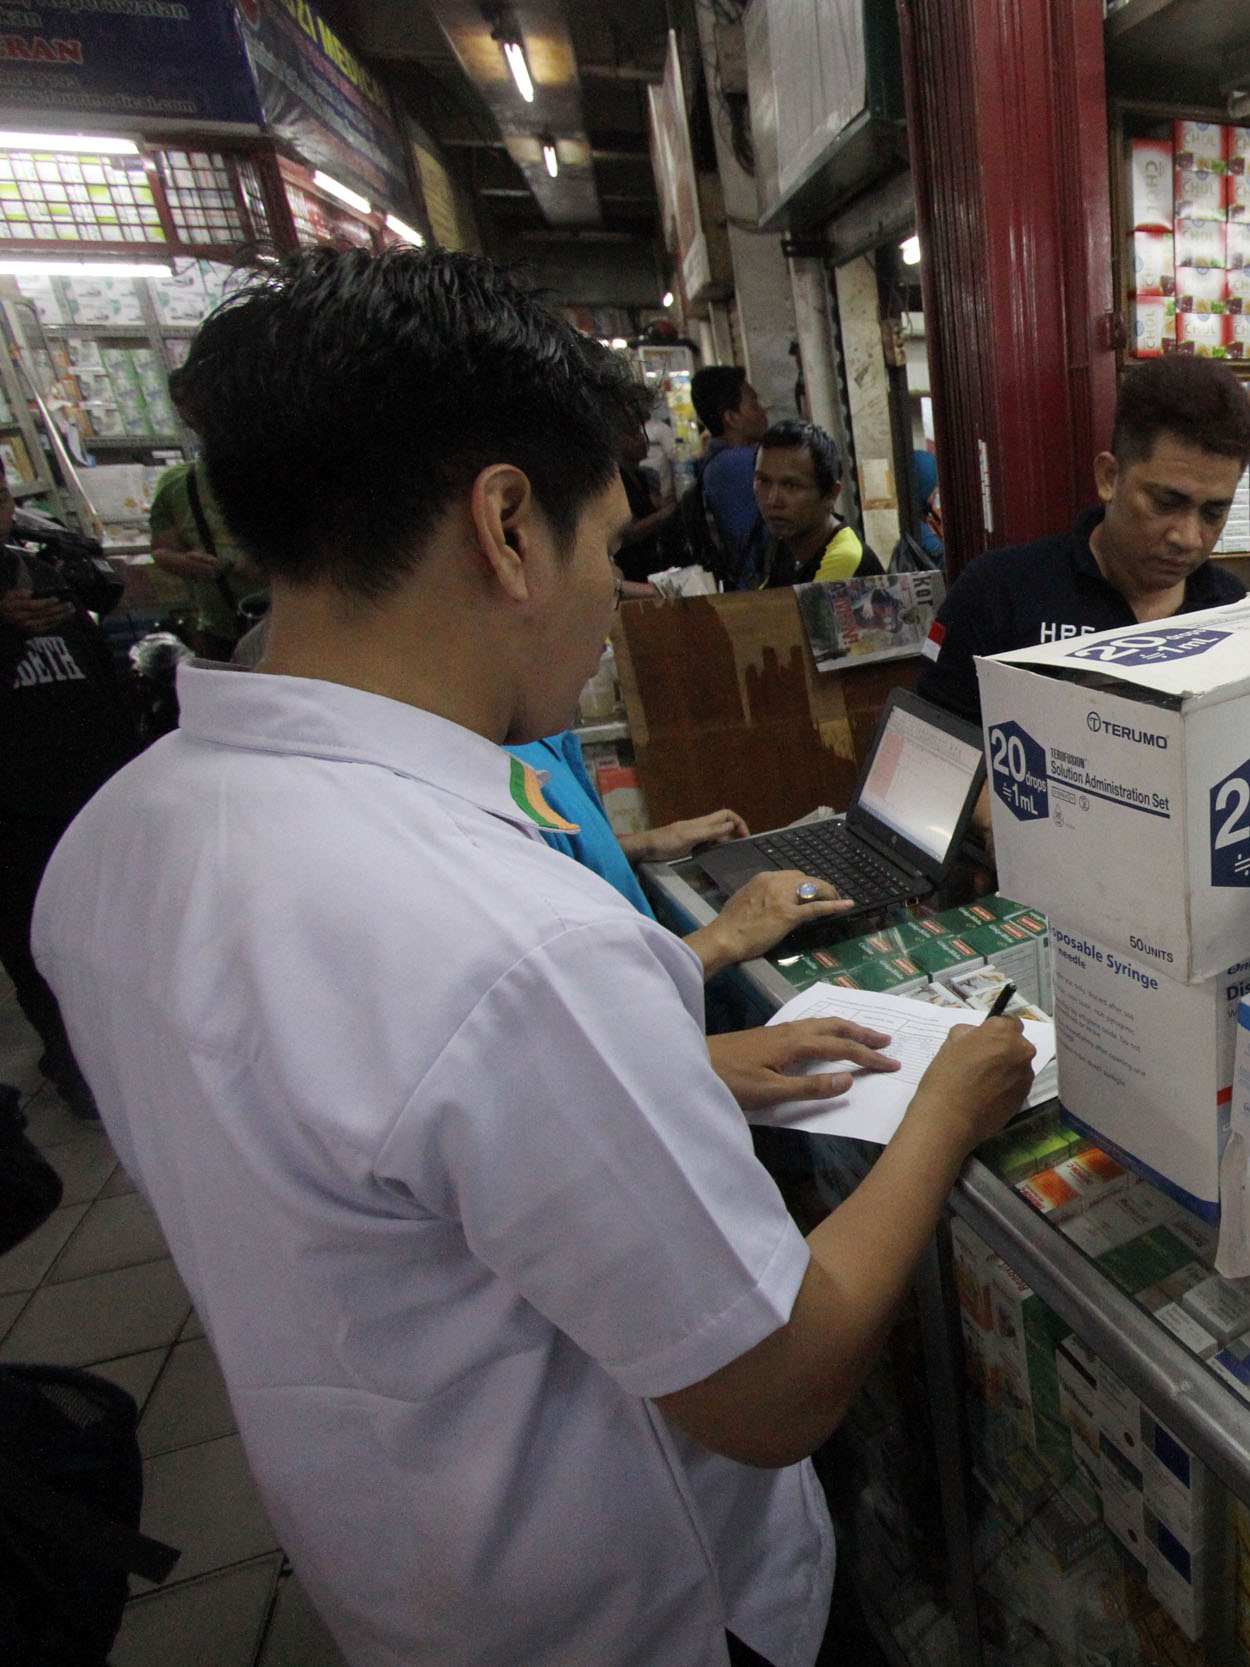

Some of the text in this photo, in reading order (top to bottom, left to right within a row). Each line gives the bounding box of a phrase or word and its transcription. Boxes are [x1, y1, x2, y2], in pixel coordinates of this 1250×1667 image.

[1074, 636, 1168, 661] 20
[1101, 720, 1168, 750] TERUMO
[990, 727, 1047, 793] 20 drops
[1050, 747, 1085, 769] TERUFUSION
[1050, 760, 1170, 812] Solution Administration Set
[1057, 947, 1087, 970] needle
[1106, 954, 1159, 990] Syringe
